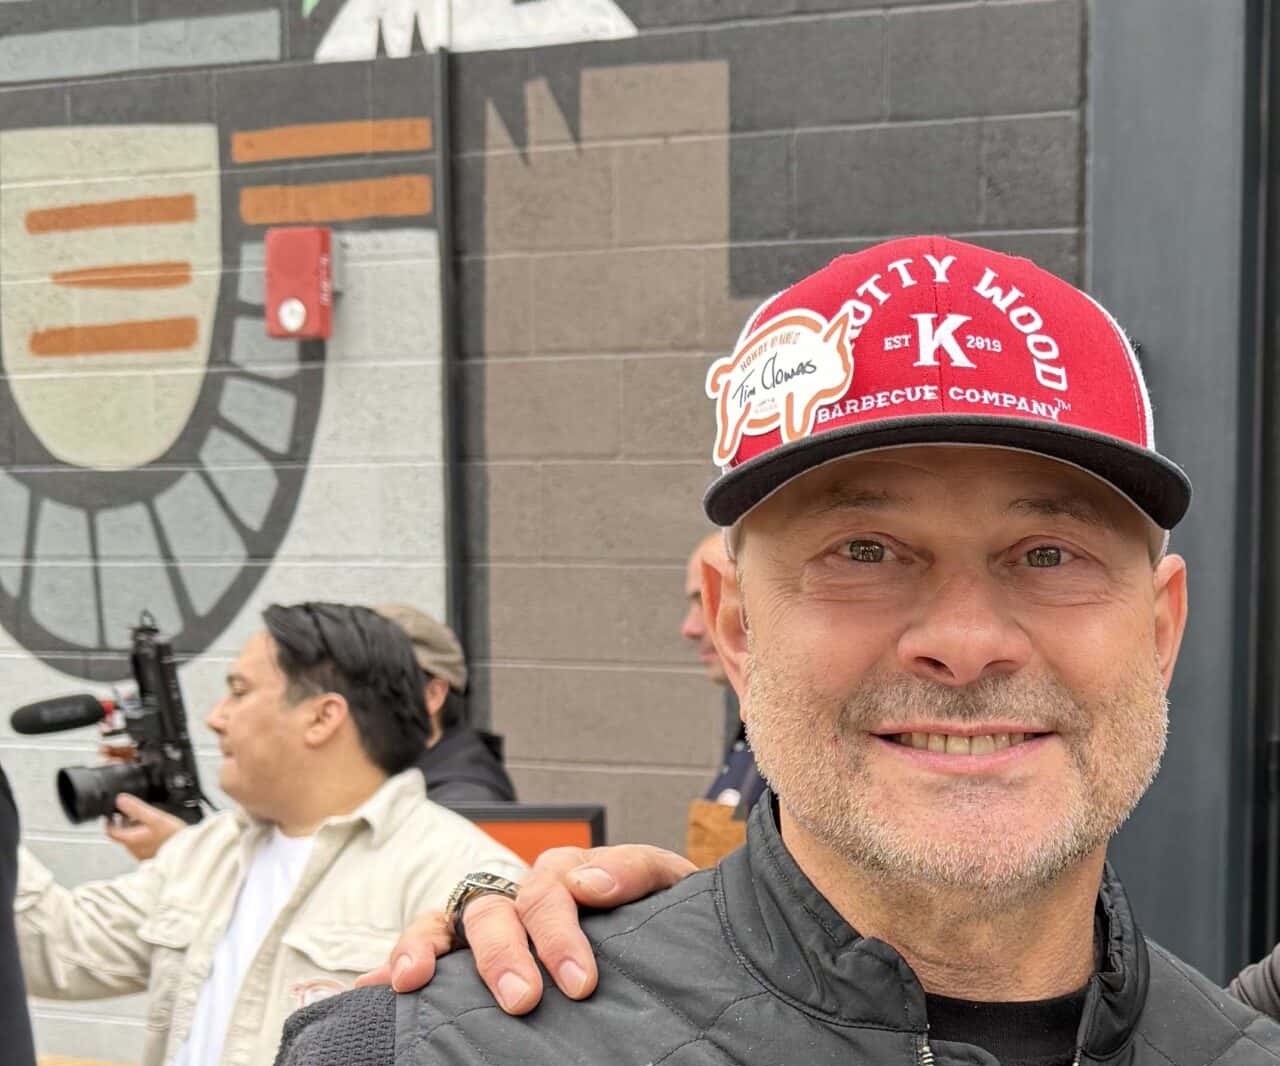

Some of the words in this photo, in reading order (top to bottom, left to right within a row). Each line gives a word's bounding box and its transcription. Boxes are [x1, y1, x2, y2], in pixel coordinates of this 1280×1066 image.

[846, 254, 957, 340] OTTY
[973, 267, 1068, 391] WOOD
[884, 334, 912, 351] EST
[909, 313, 977, 369] K
[965, 335, 1003, 353] 2019
[816, 384, 939, 424] BARBECUE
[948, 386, 1060, 422] COMPANY
